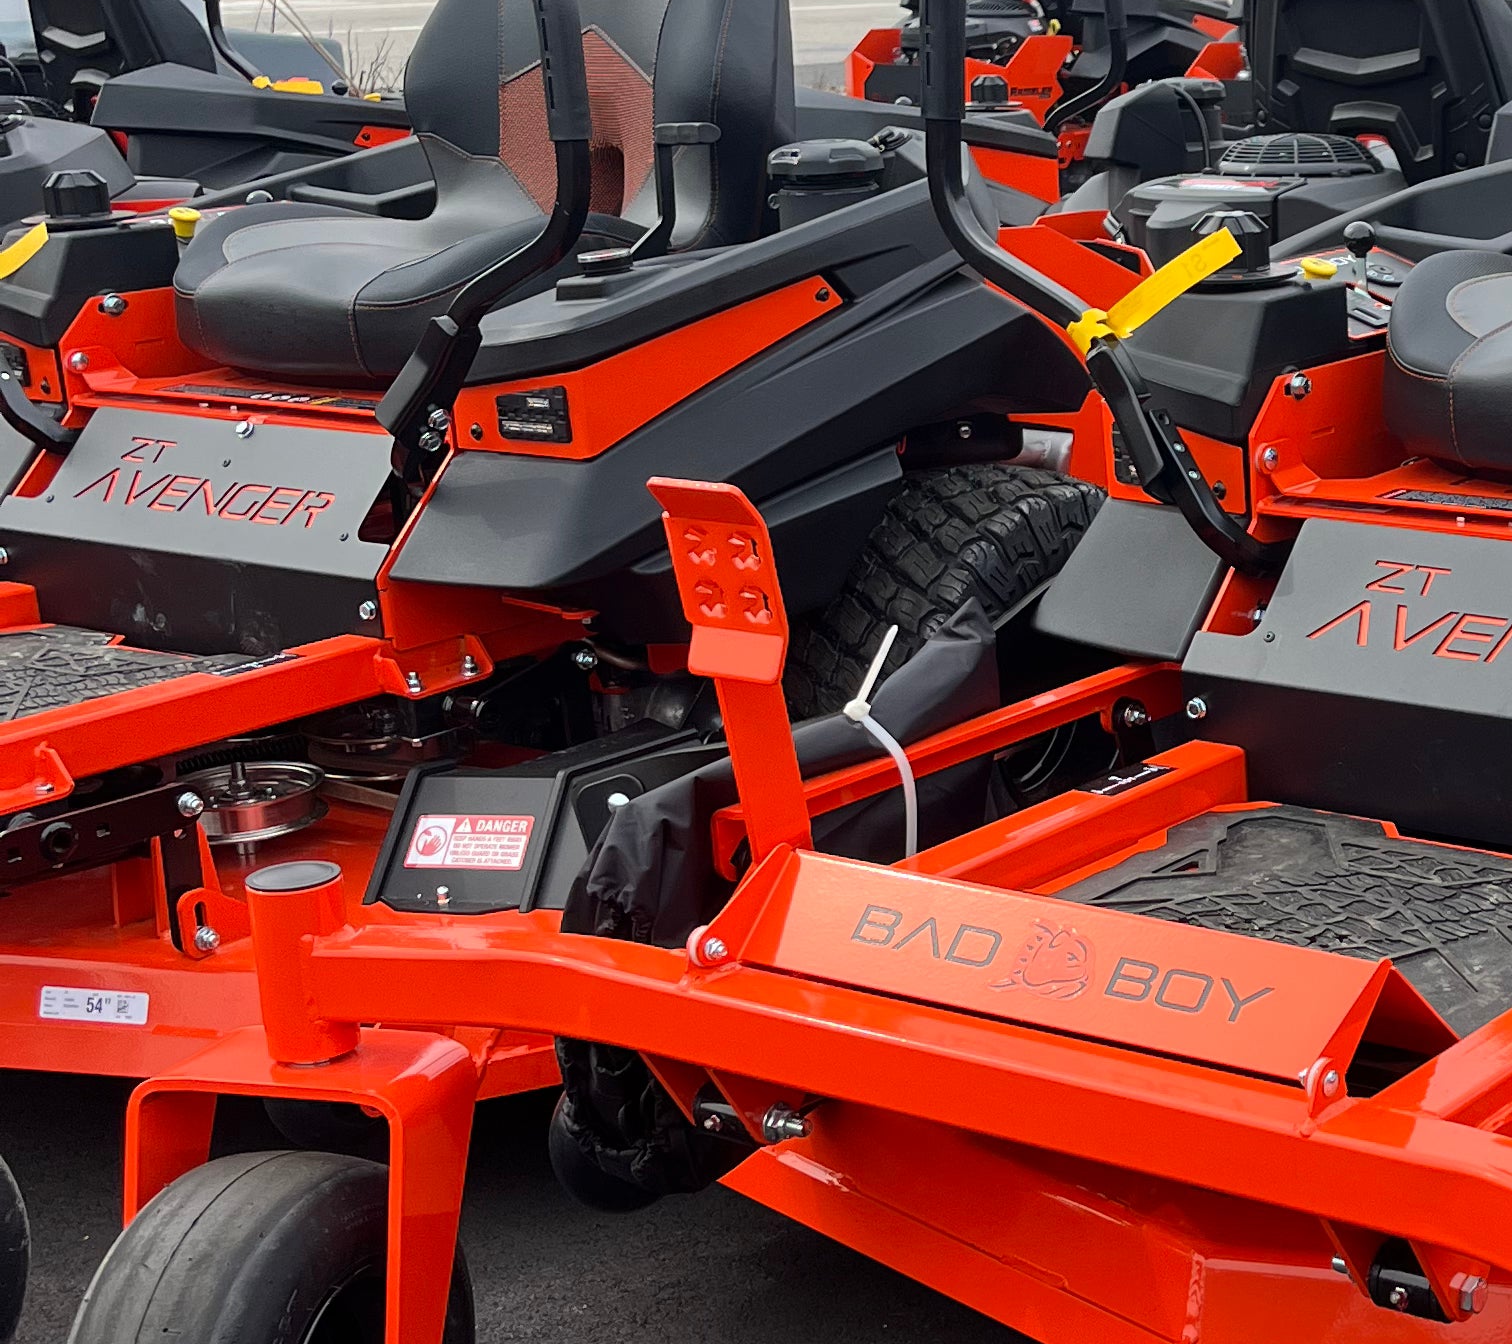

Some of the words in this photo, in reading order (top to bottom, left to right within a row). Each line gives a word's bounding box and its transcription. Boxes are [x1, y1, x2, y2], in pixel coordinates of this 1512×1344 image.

[121, 436, 178, 464] ZT
[73, 467, 336, 529] AVENGER
[1366, 559, 1453, 598] ZT
[475, 819, 529, 833] DANGER
[850, 903, 1003, 968] BAD
[1103, 956, 1275, 1023] BOY
